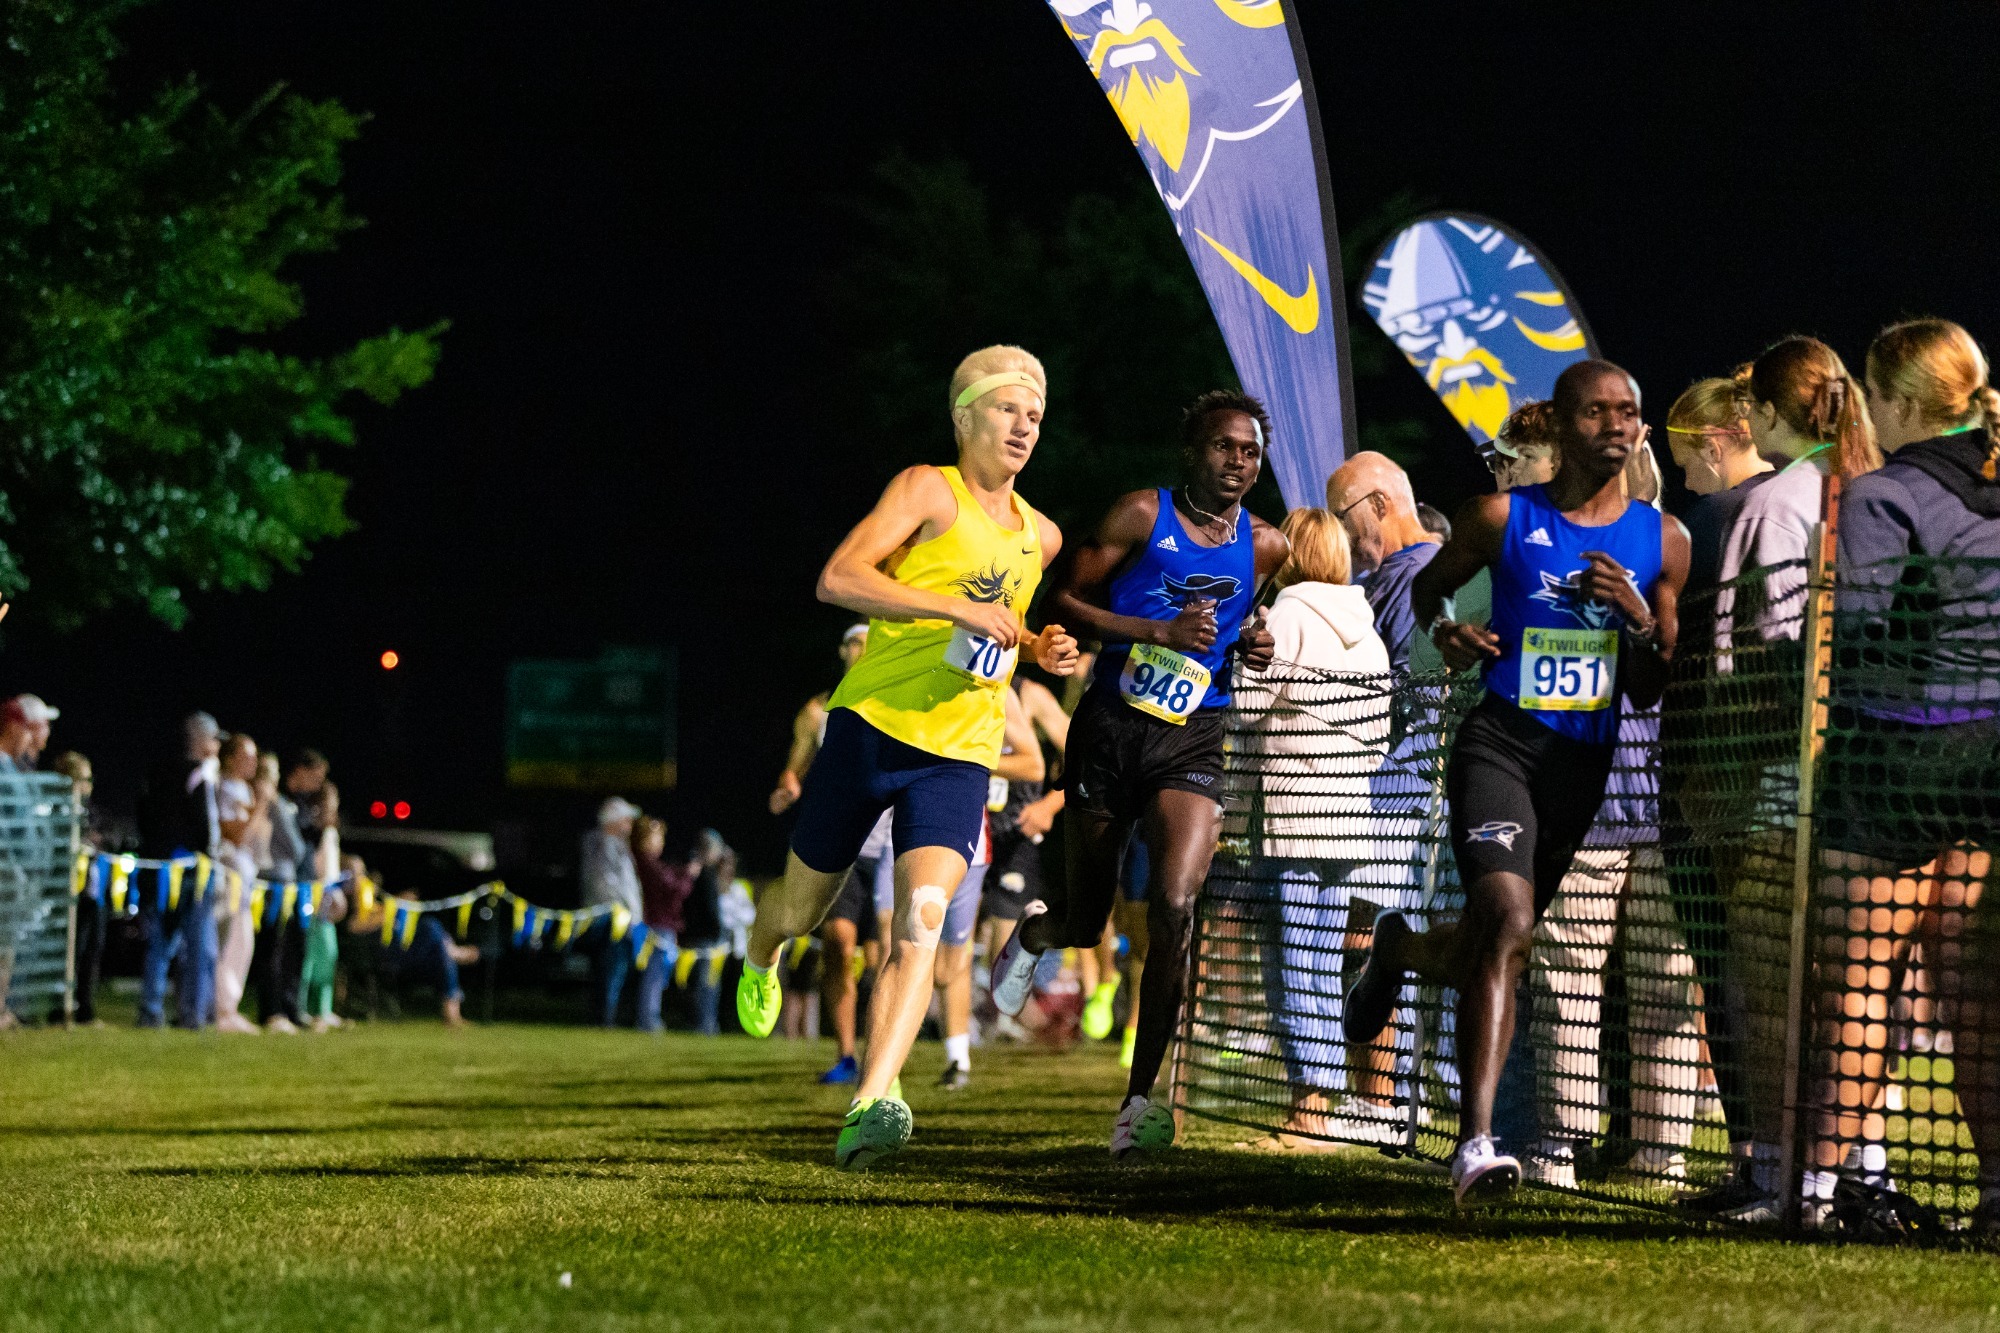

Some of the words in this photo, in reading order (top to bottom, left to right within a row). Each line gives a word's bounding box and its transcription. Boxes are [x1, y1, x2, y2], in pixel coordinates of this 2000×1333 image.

[966, 635, 1001, 678] 70
[1152, 652, 1205, 682] TWILIGHT
[1533, 655, 1601, 697] 951
[1129, 662, 1194, 714] 948
